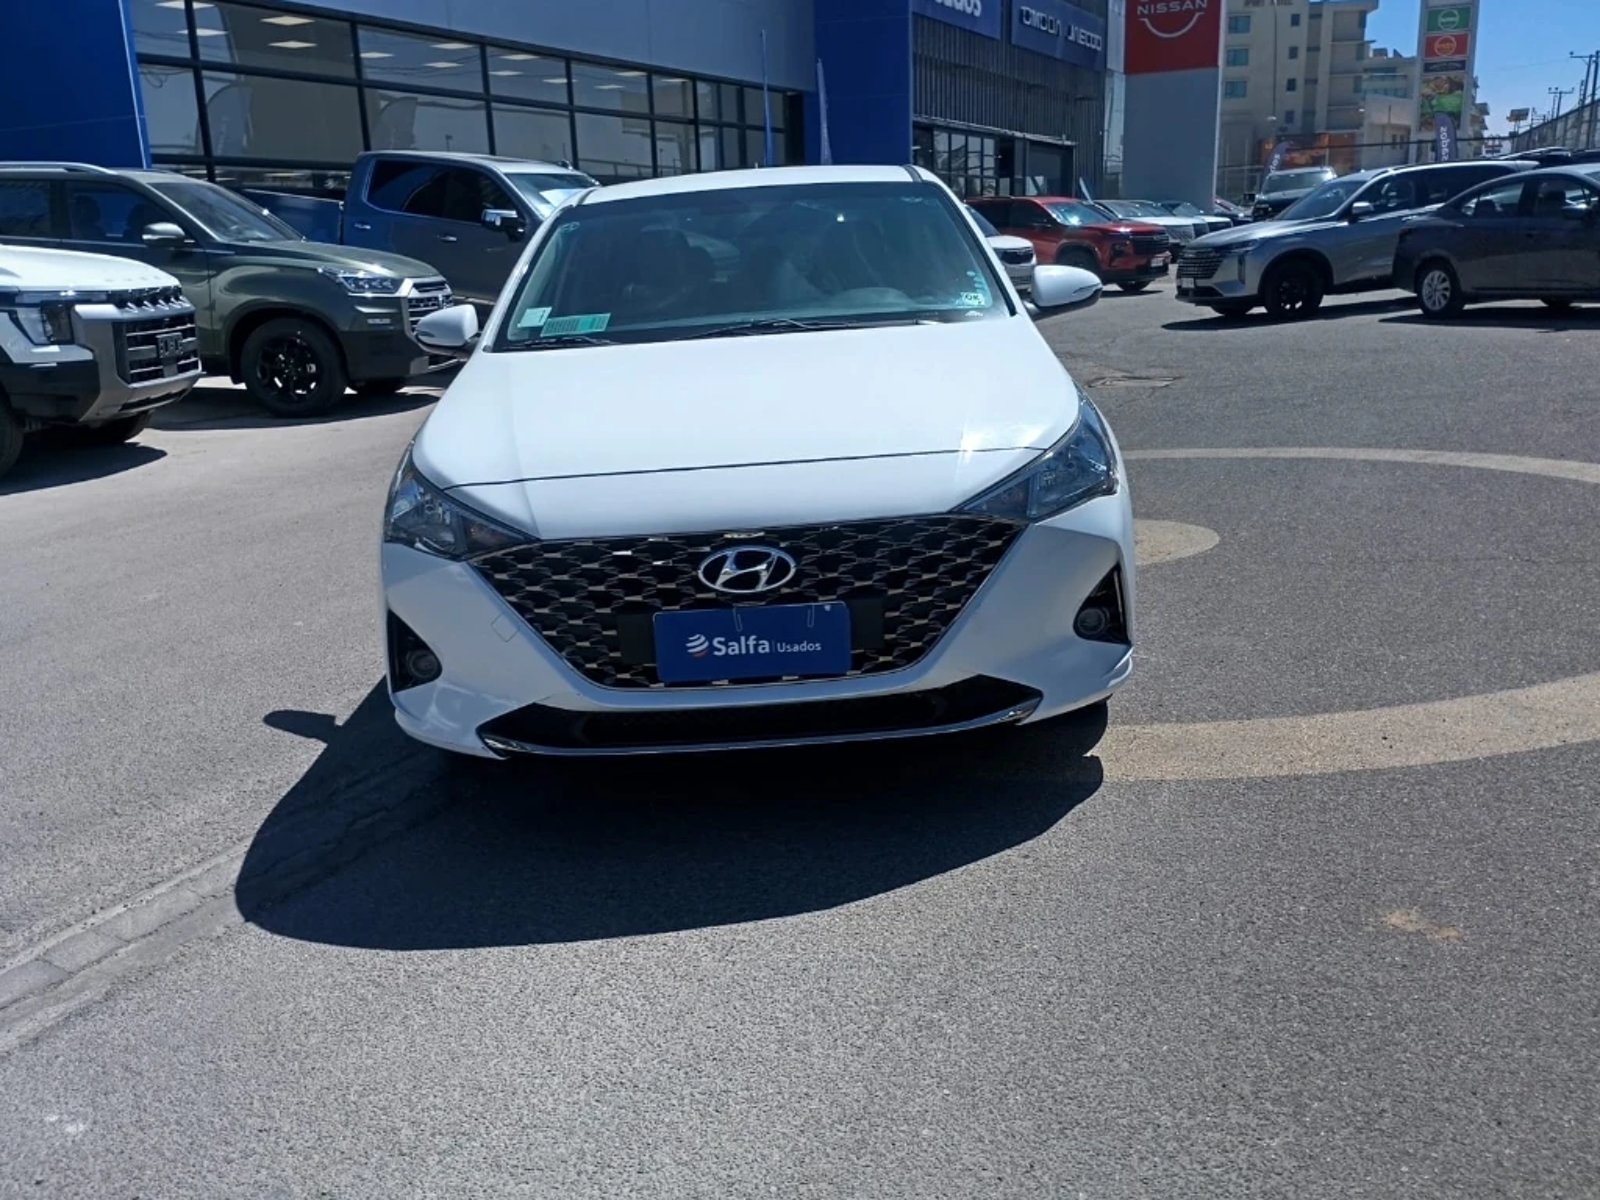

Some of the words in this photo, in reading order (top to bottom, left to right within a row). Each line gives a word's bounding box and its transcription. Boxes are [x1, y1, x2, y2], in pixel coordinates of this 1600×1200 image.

[1137, 0, 1208, 15] NISSAN
[712, 635, 770, 656] Salfa
[777, 640, 822, 653] Usados
